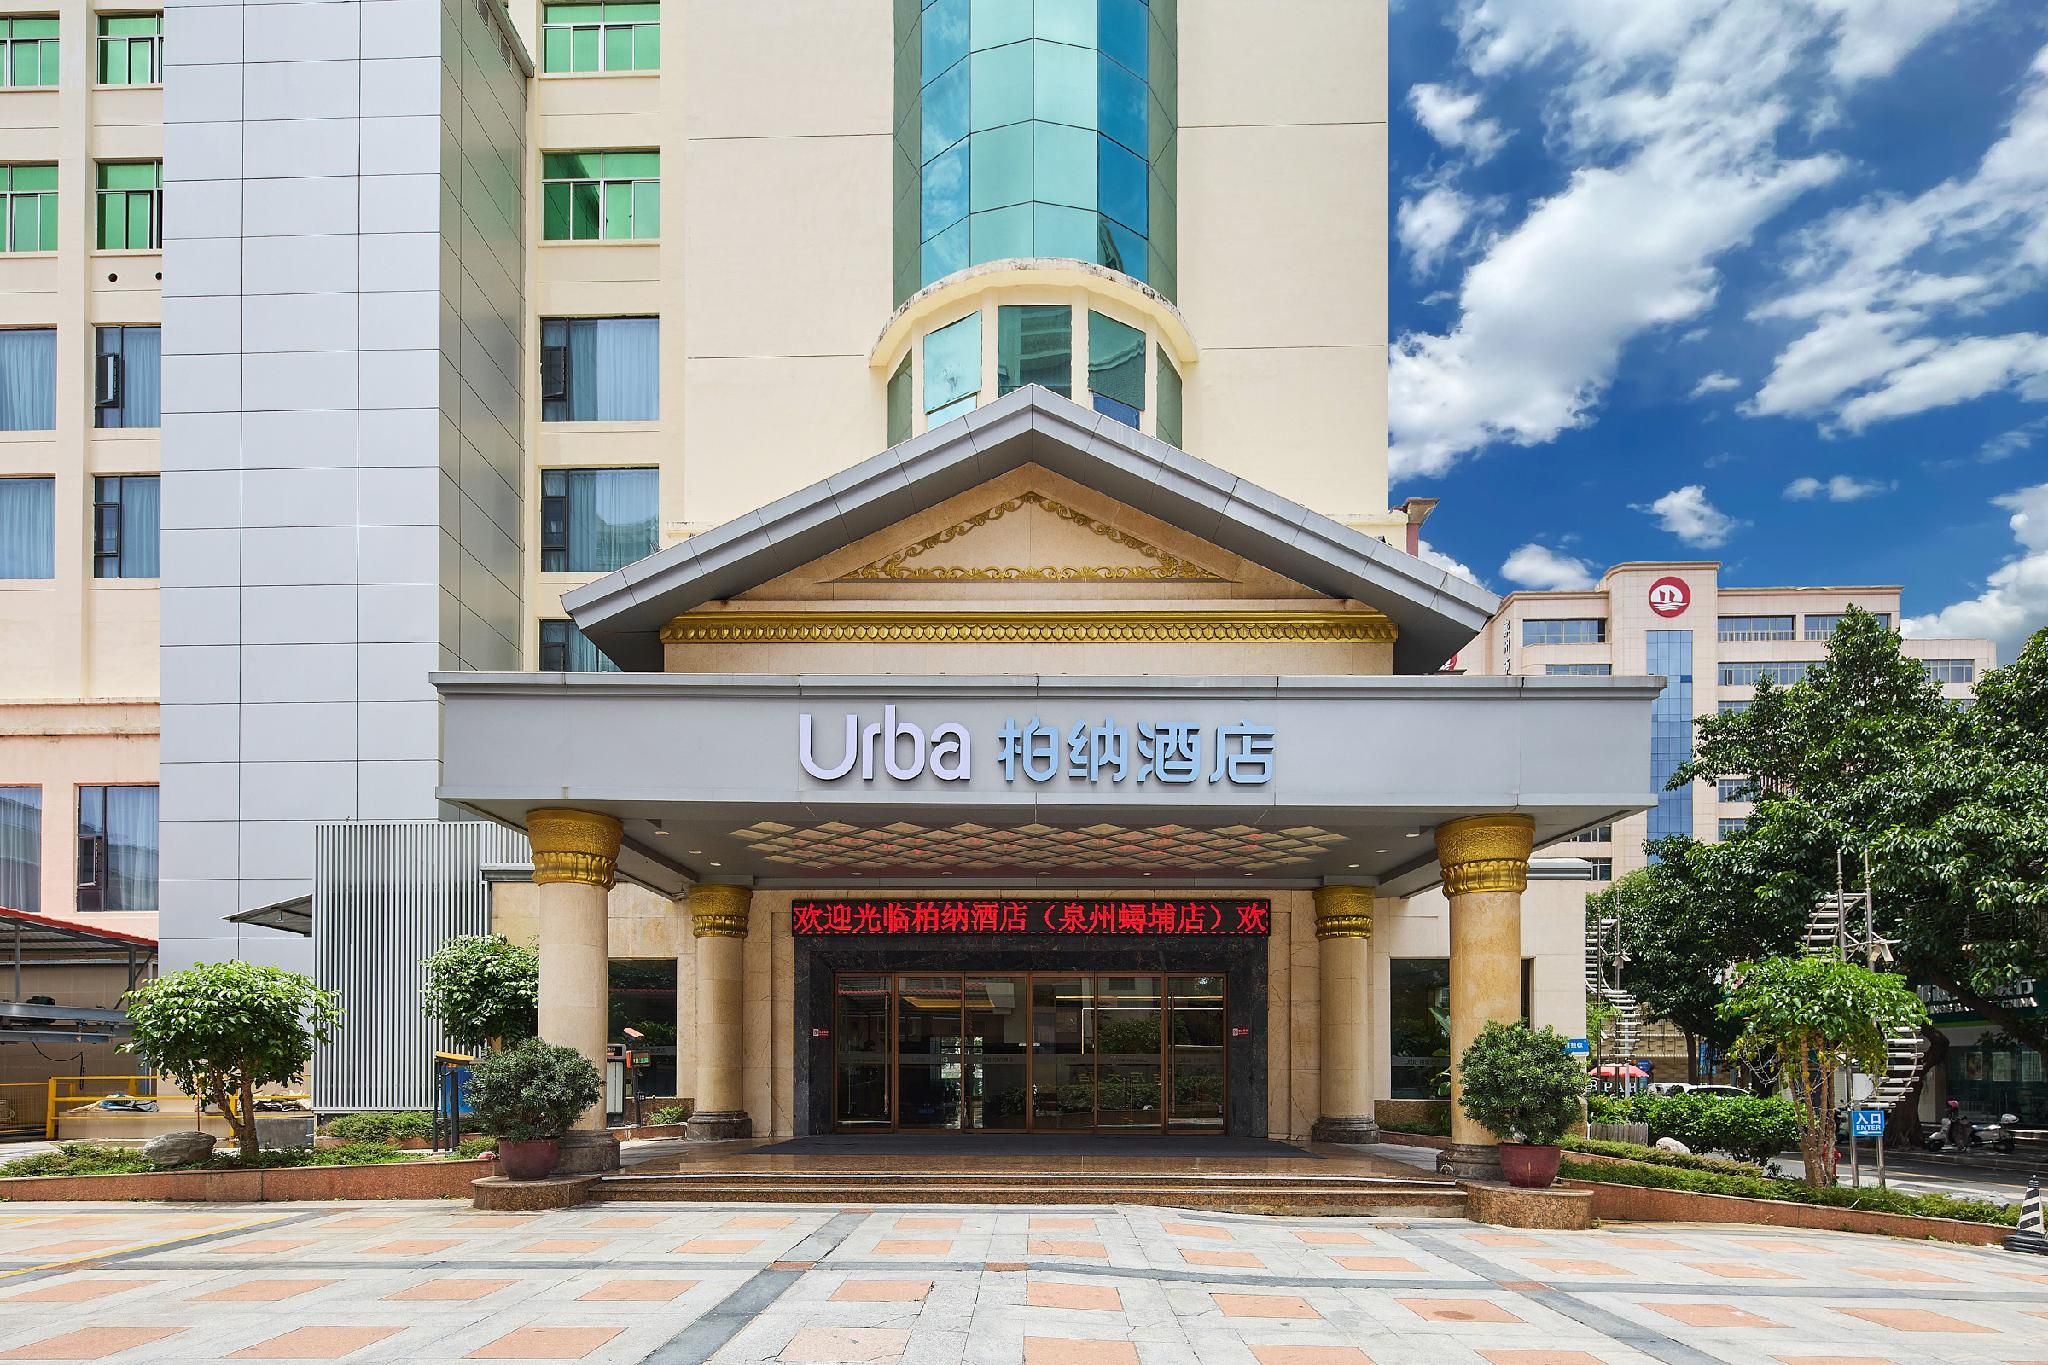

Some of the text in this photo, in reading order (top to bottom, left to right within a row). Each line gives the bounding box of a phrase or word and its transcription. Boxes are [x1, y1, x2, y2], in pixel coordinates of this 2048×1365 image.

[799, 704, 971, 781] Urba
[997, 714, 1276, 784] 柏纳酒店
[1856, 1112, 1881, 1124] 入口
